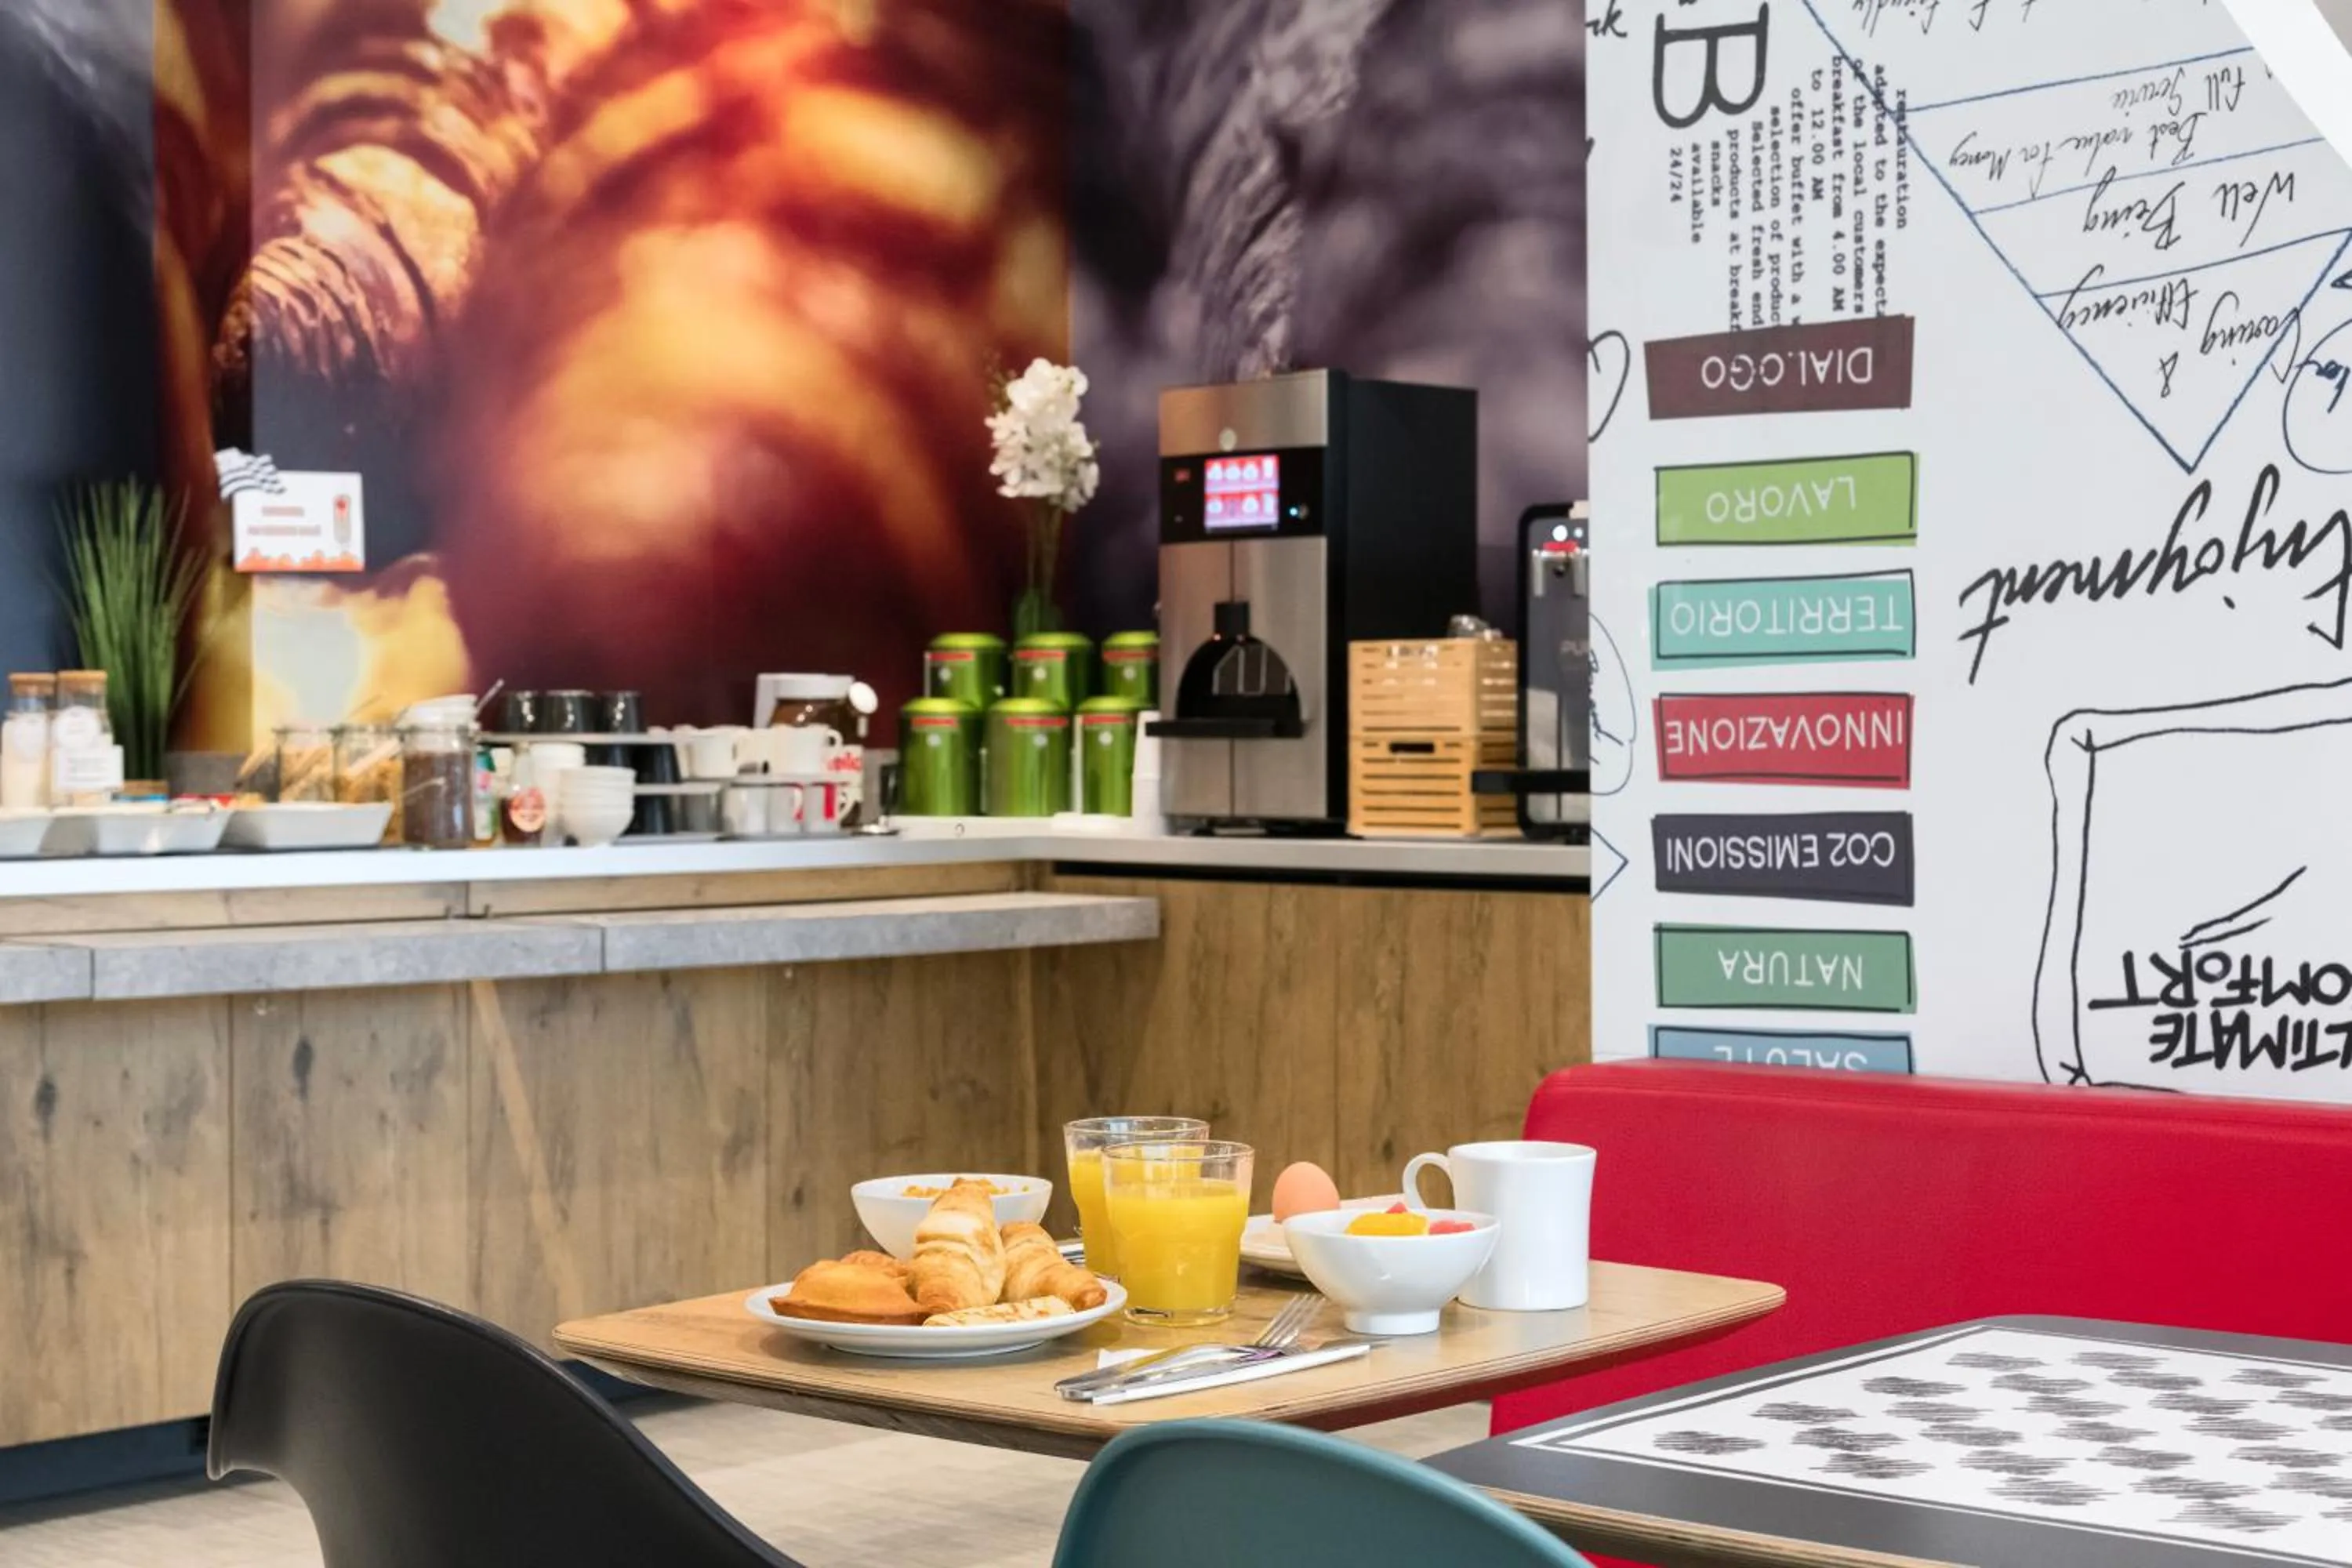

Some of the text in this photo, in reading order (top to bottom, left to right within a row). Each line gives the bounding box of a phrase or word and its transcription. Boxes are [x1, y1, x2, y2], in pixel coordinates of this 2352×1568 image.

[1791, 87, 1803, 144] offer
[1853, 94, 1865, 129] the
[1871, 64, 1887, 147] adapted
[1811, 68, 1824, 201] to 12.00 AM
[1948, 131, 2008, 181] Money
[2060, 126, 2132, 178] value
[2149, 111, 2208, 166] Best
[1670, 147, 1682, 202] 24/24
[1691, 143, 1704, 243] available
[1711, 140, 1722, 207] snacks
[1727, 129, 1740, 219] products
[1751, 121, 1764, 212] Selected
[1791, 155, 1804, 225] buffet
[1832, 55, 1846, 312] breakfast from 4.00 AM
[1853, 141, 1866, 197] local
[1875, 158, 1888, 181] to
[1768, 106, 1784, 327] selection of produc
[1875, 193, 1888, 227] the
[2083, 165, 2295, 250] Well Being
[1730, 232, 1740, 253] at
[1751, 225, 1764, 280] fresh
[1791, 237, 1804, 283] with
[1853, 210, 1865, 314] customers
[1791, 293, 1802, 305] a
[1705, 476, 1857, 523] LAVORO
[1670, 594, 1904, 637] TERRITORIO
[1664, 710, 1904, 757] INNOVAZIONE
[1666, 831, 1896, 873] CO2 EMISSIONI
[1717, 949, 1864, 991] NATURA
